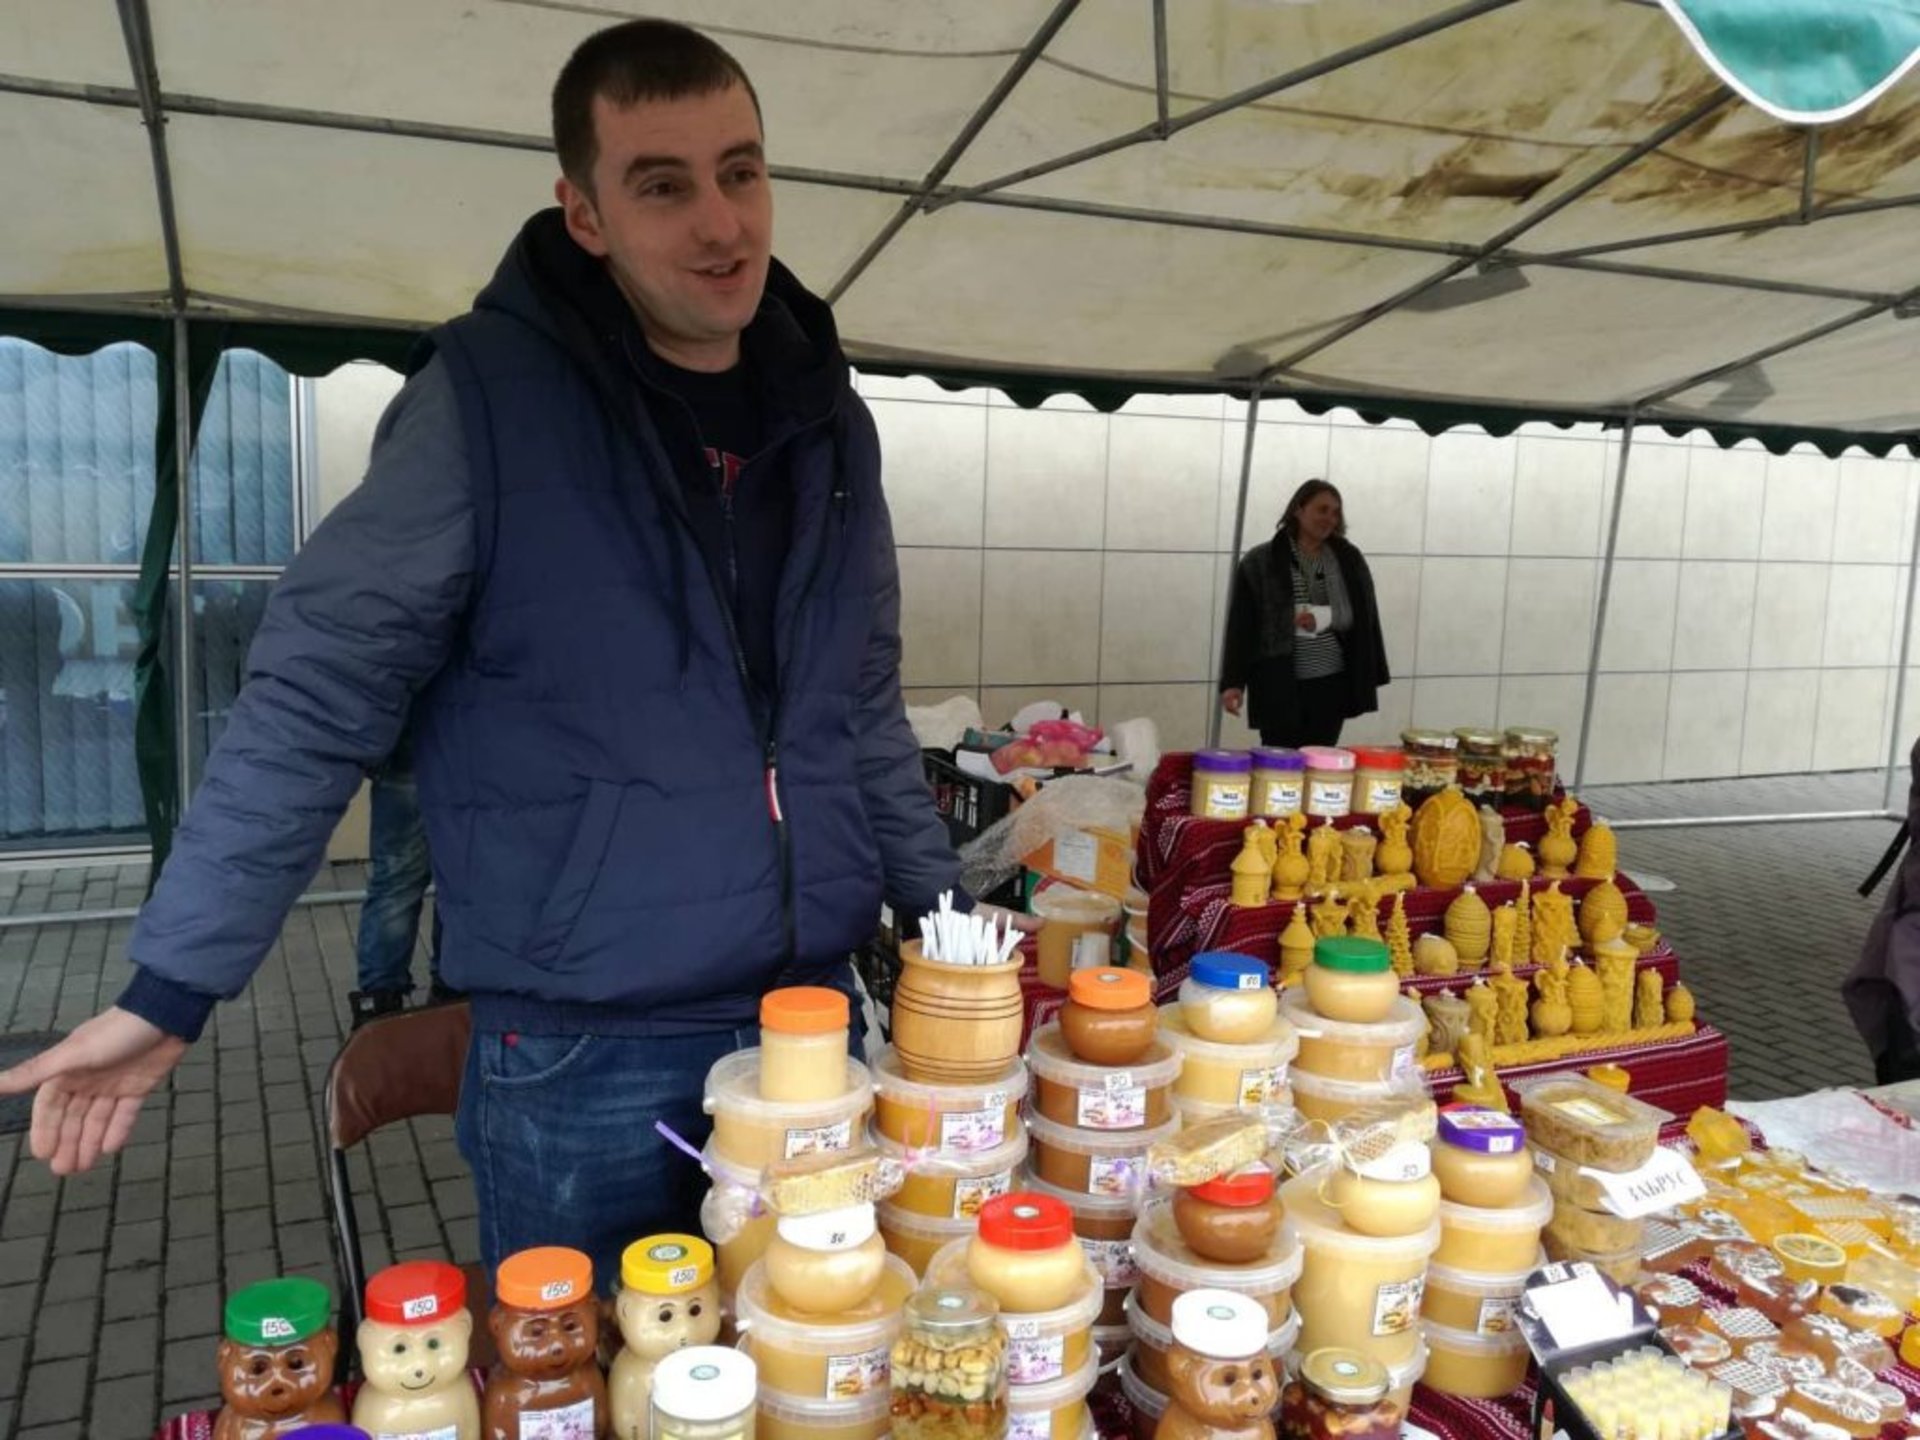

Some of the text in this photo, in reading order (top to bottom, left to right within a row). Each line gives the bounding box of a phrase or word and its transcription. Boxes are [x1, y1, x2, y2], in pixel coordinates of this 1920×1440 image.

[673, 1267, 696, 1284] 150
[546, 1281, 571, 1298] 150
[409, 1298, 434, 1314] 150
[264, 1320, 290, 1335] 150
[1013, 1321, 1035, 1336] 100
